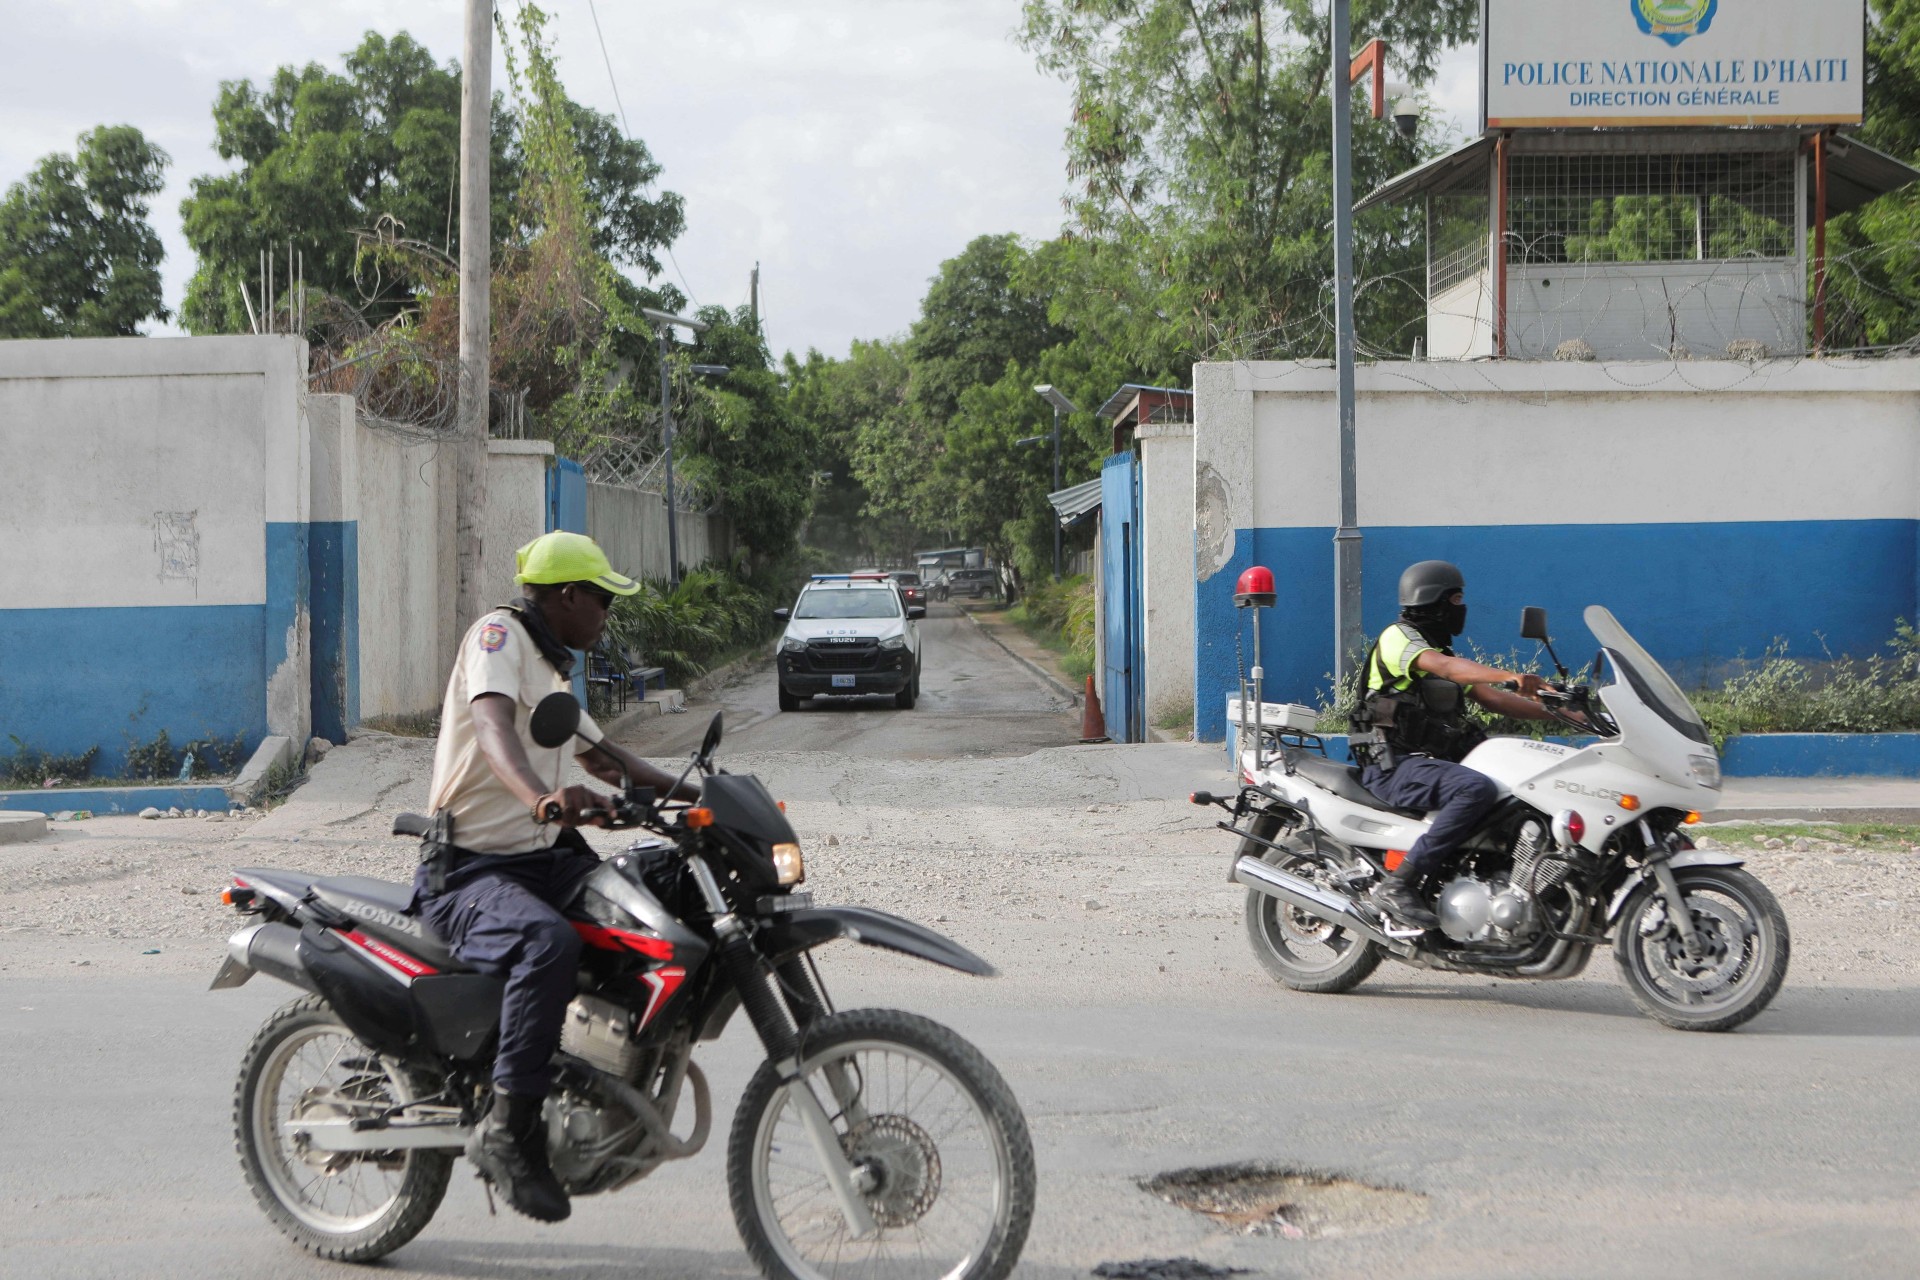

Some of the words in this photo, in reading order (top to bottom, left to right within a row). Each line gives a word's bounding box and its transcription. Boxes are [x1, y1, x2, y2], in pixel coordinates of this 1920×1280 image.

[1503, 61, 1593, 86] POLICE
[1601, 59, 1745, 85] NATIONALE
[1753, 58, 1848, 83] D'HAITI
[1570, 91, 1670, 107] DIRECTION
[1677, 87, 1779, 106] GÉNÉRALE
[1522, 741, 1565, 756] YAMAHA
[1554, 779, 1622, 801] POLICE
[342, 899, 423, 938] HONDA
